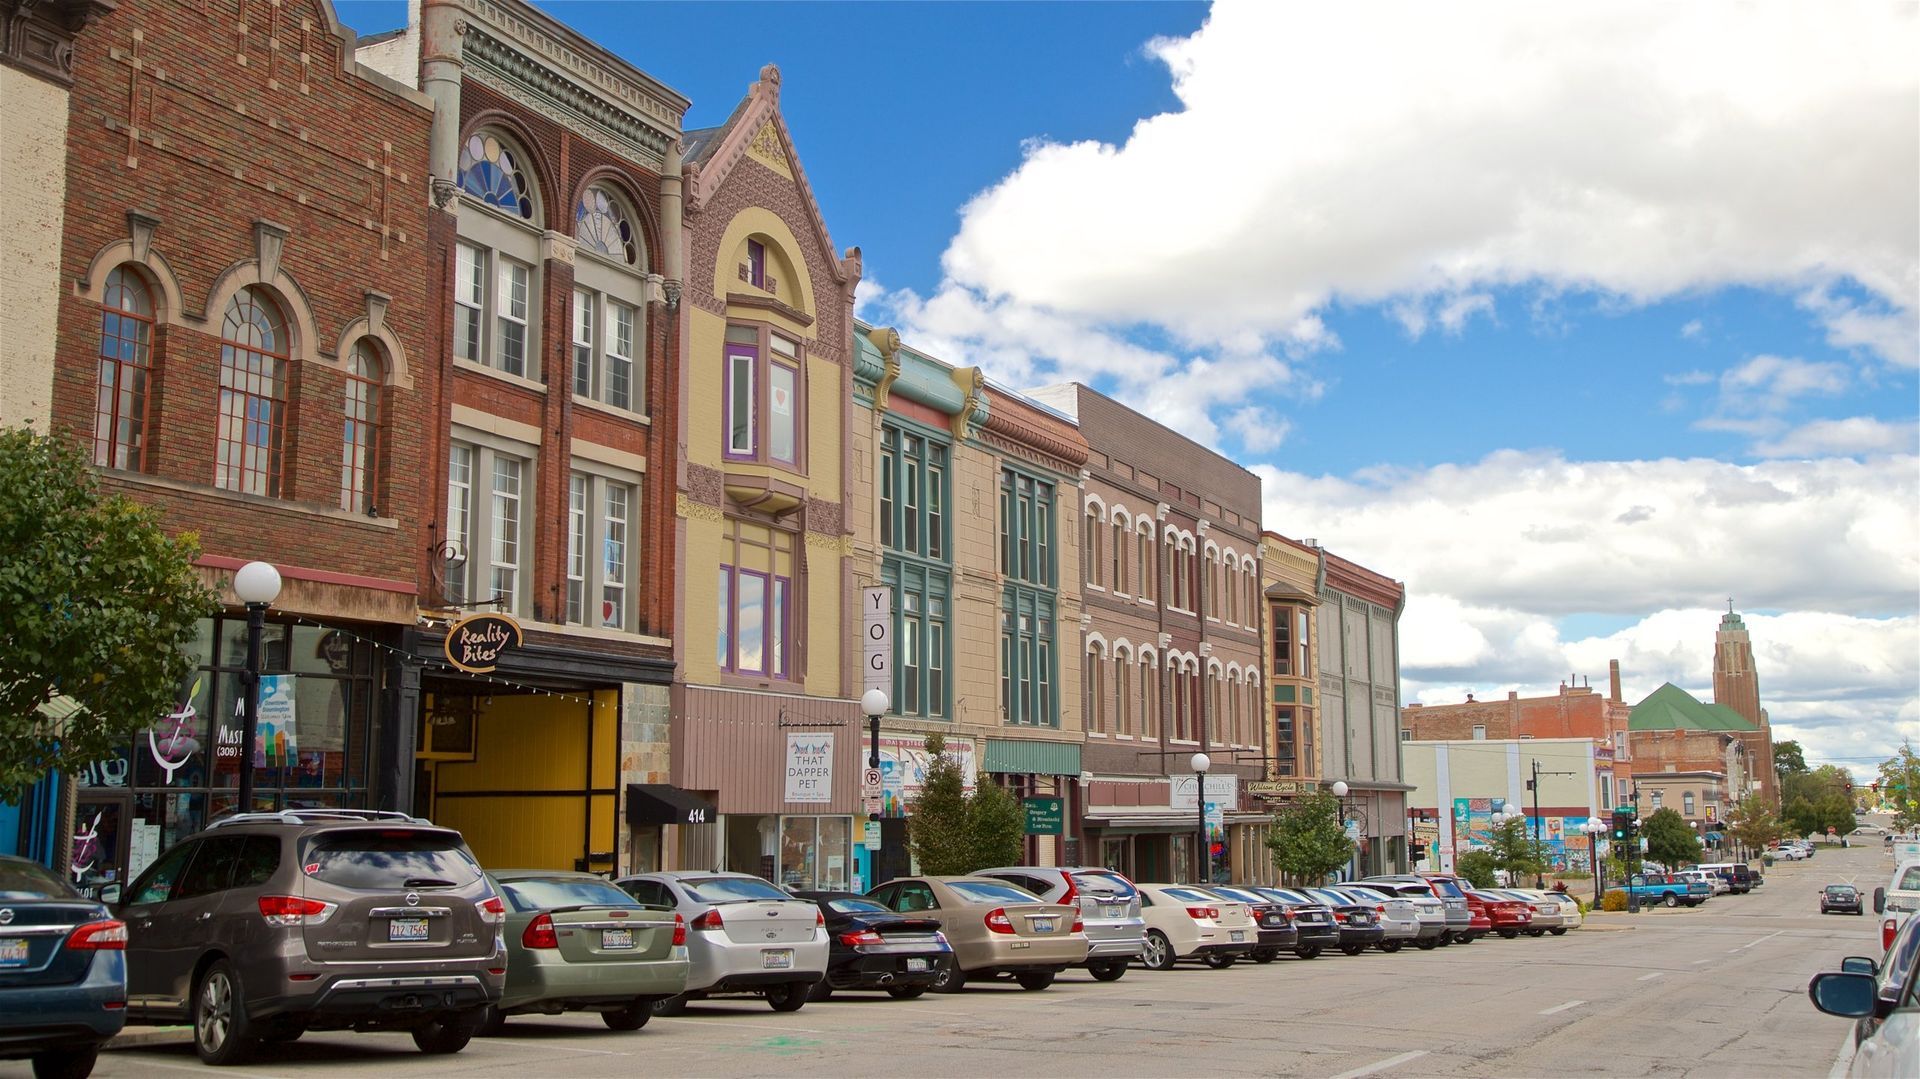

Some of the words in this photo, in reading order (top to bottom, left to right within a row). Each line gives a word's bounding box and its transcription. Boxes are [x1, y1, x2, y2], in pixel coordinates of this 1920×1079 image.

[460, 623, 510, 651] Reality
[870, 593, 885, 690] YOG
[462, 645, 496, 664] Bites
[216, 746, 238, 757] (309)
[795, 755, 825, 766] THAT
[788, 767, 829, 777] DAPPER
[798, 779, 818, 789] PET
[1184, 781, 1231, 790] CHUCHILL'S
[688, 809, 705, 823] 414
[409, 924, 428, 936] 7565
